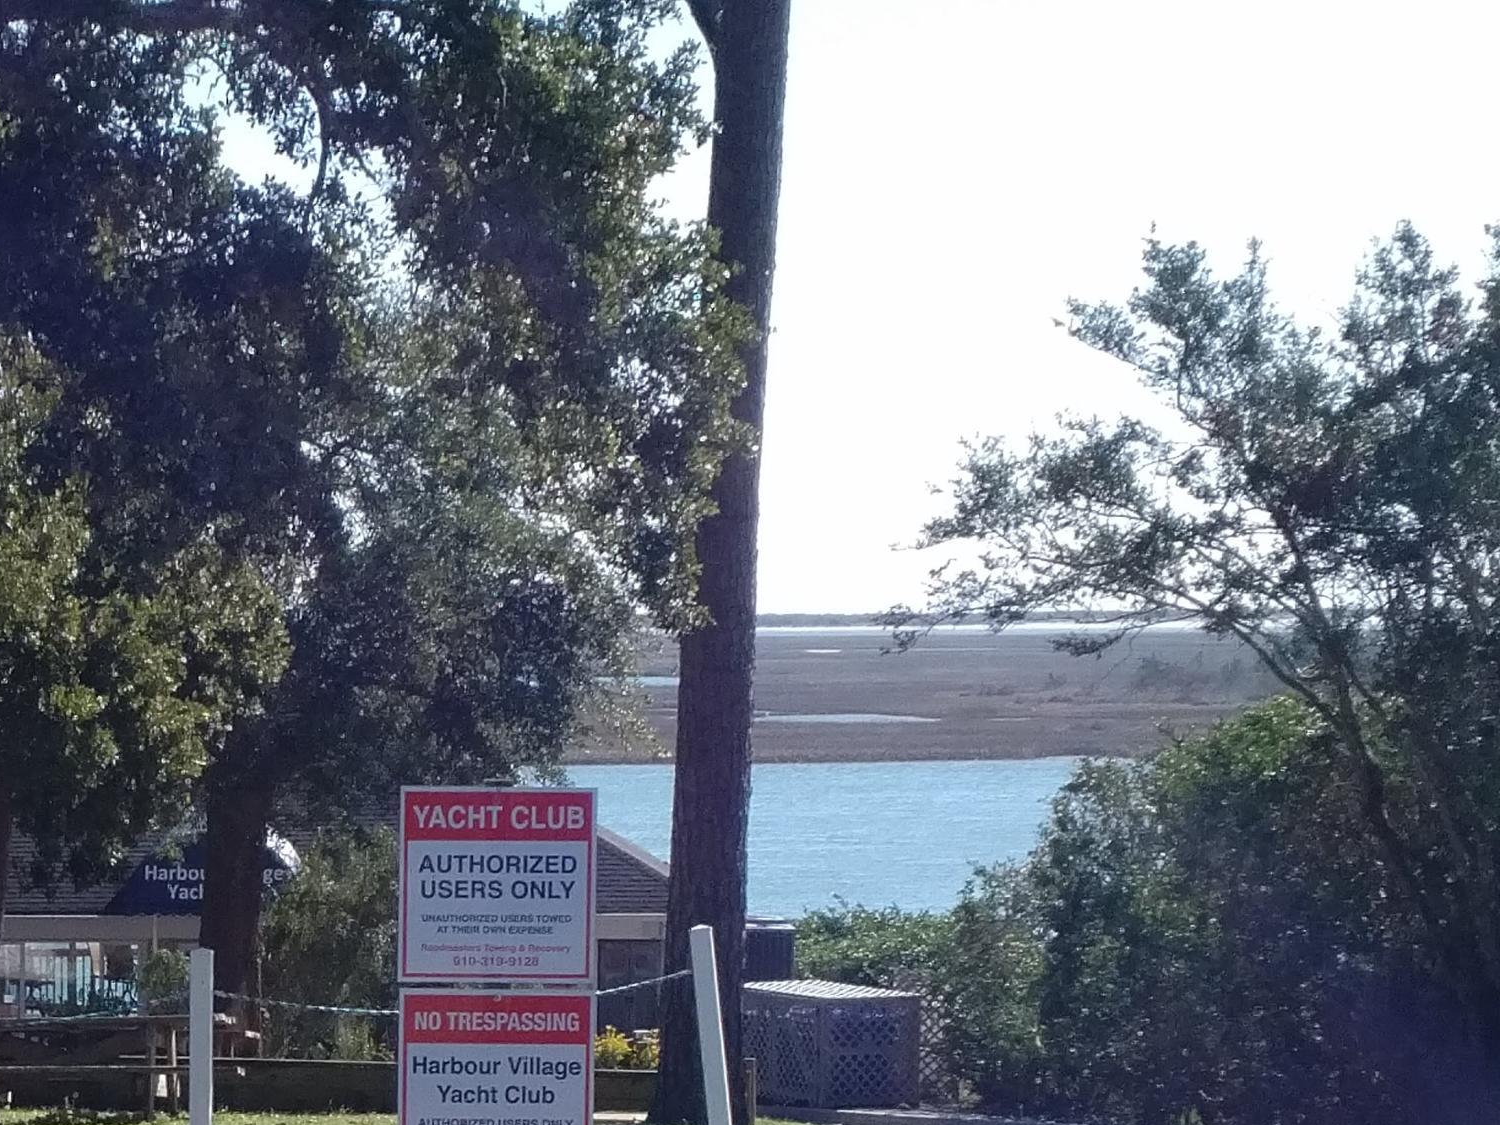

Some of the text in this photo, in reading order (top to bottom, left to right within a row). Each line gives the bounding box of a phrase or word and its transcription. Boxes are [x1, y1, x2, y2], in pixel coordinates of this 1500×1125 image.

[412, 805, 585, 829] YACHT CLUB
[418, 854, 577, 874] AUTHORIZED
[420, 880, 576, 900] USERS ONLY
[421, 914, 573, 924] UNAUTHORIZED USERS TOWED
[436, 926, 554, 935] AT THEIR OWN EXPENSE
[414, 1011, 580, 1032] NO TRESPASSING
[412, 1056, 582, 1080] Harbour Village
[437, 1085, 555, 1105] Yacht Club
